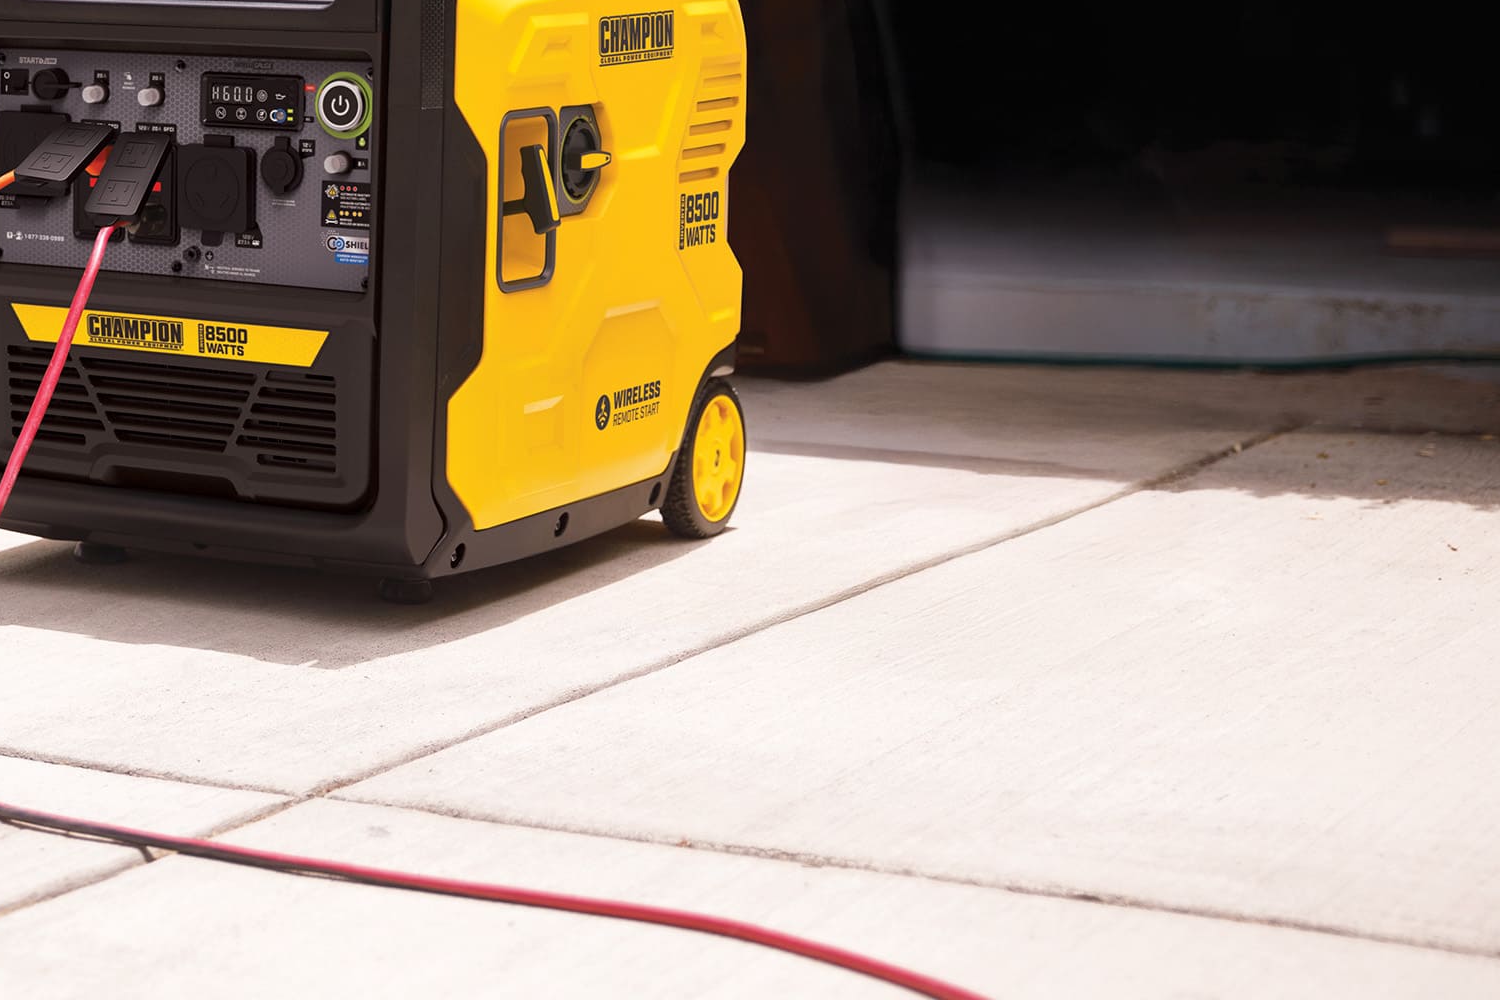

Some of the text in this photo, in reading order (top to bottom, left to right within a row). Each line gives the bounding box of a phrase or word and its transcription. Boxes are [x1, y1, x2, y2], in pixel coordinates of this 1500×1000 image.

[600, 12, 673, 54] CHAMPION
[600, 56, 622, 64] GLOBAL
[643, 50, 673, 59] EQUIPMENT
[686, 191, 719, 224] 8500
[345, 240, 369, 250] SHIEL
[686, 223, 716, 247] WATTS
[88, 315, 183, 344] CHAMPION
[205, 326, 248, 344] 8500
[206, 342, 244, 356] WATTS
[613, 380, 661, 410] WIRELESS
[612, 401, 660, 427] REMOTE START
